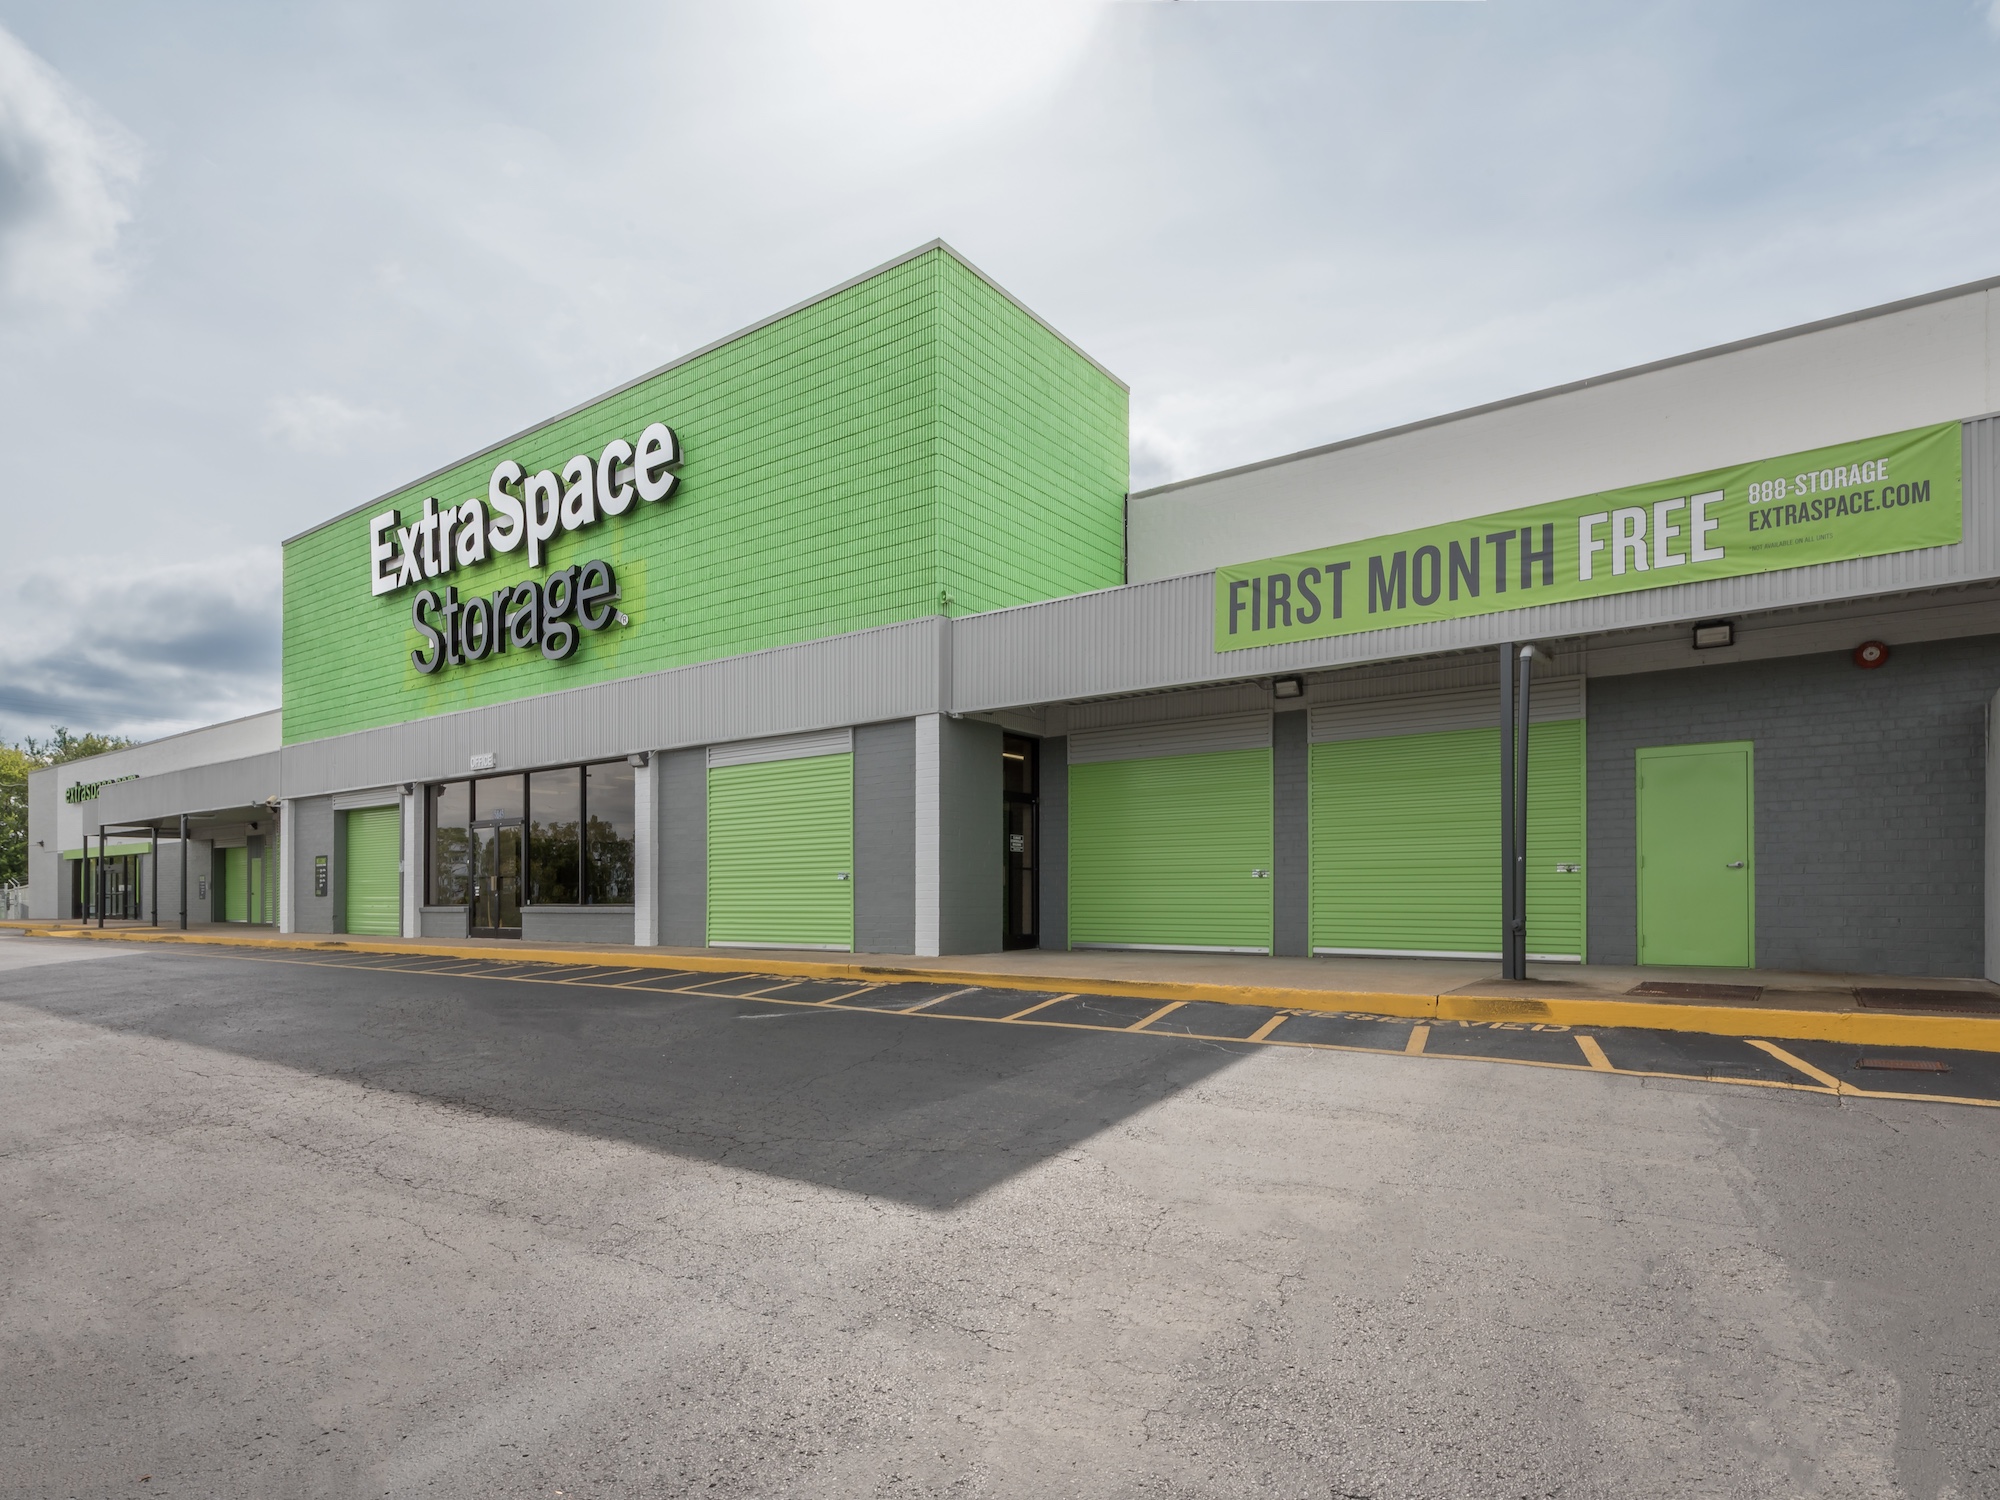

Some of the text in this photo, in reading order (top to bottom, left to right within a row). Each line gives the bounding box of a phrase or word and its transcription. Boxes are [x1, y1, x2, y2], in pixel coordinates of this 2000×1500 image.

[1748, 457, 1889, 505] 888-STORAGE
[1749, 480, 1930, 532] EXTRASPACE.COM
[370, 422, 682, 597] ExtraSpace
[1229, 488, 1726, 635] FIRST MONTH FREE
[1764, 538, 1793, 550] AVAILABLE
[1794, 537, 1804, 545] ON
[1816, 532, 1834, 541] UNITS
[411, 559, 617, 674] Storage
[470, 754, 493, 768] OFFICE
